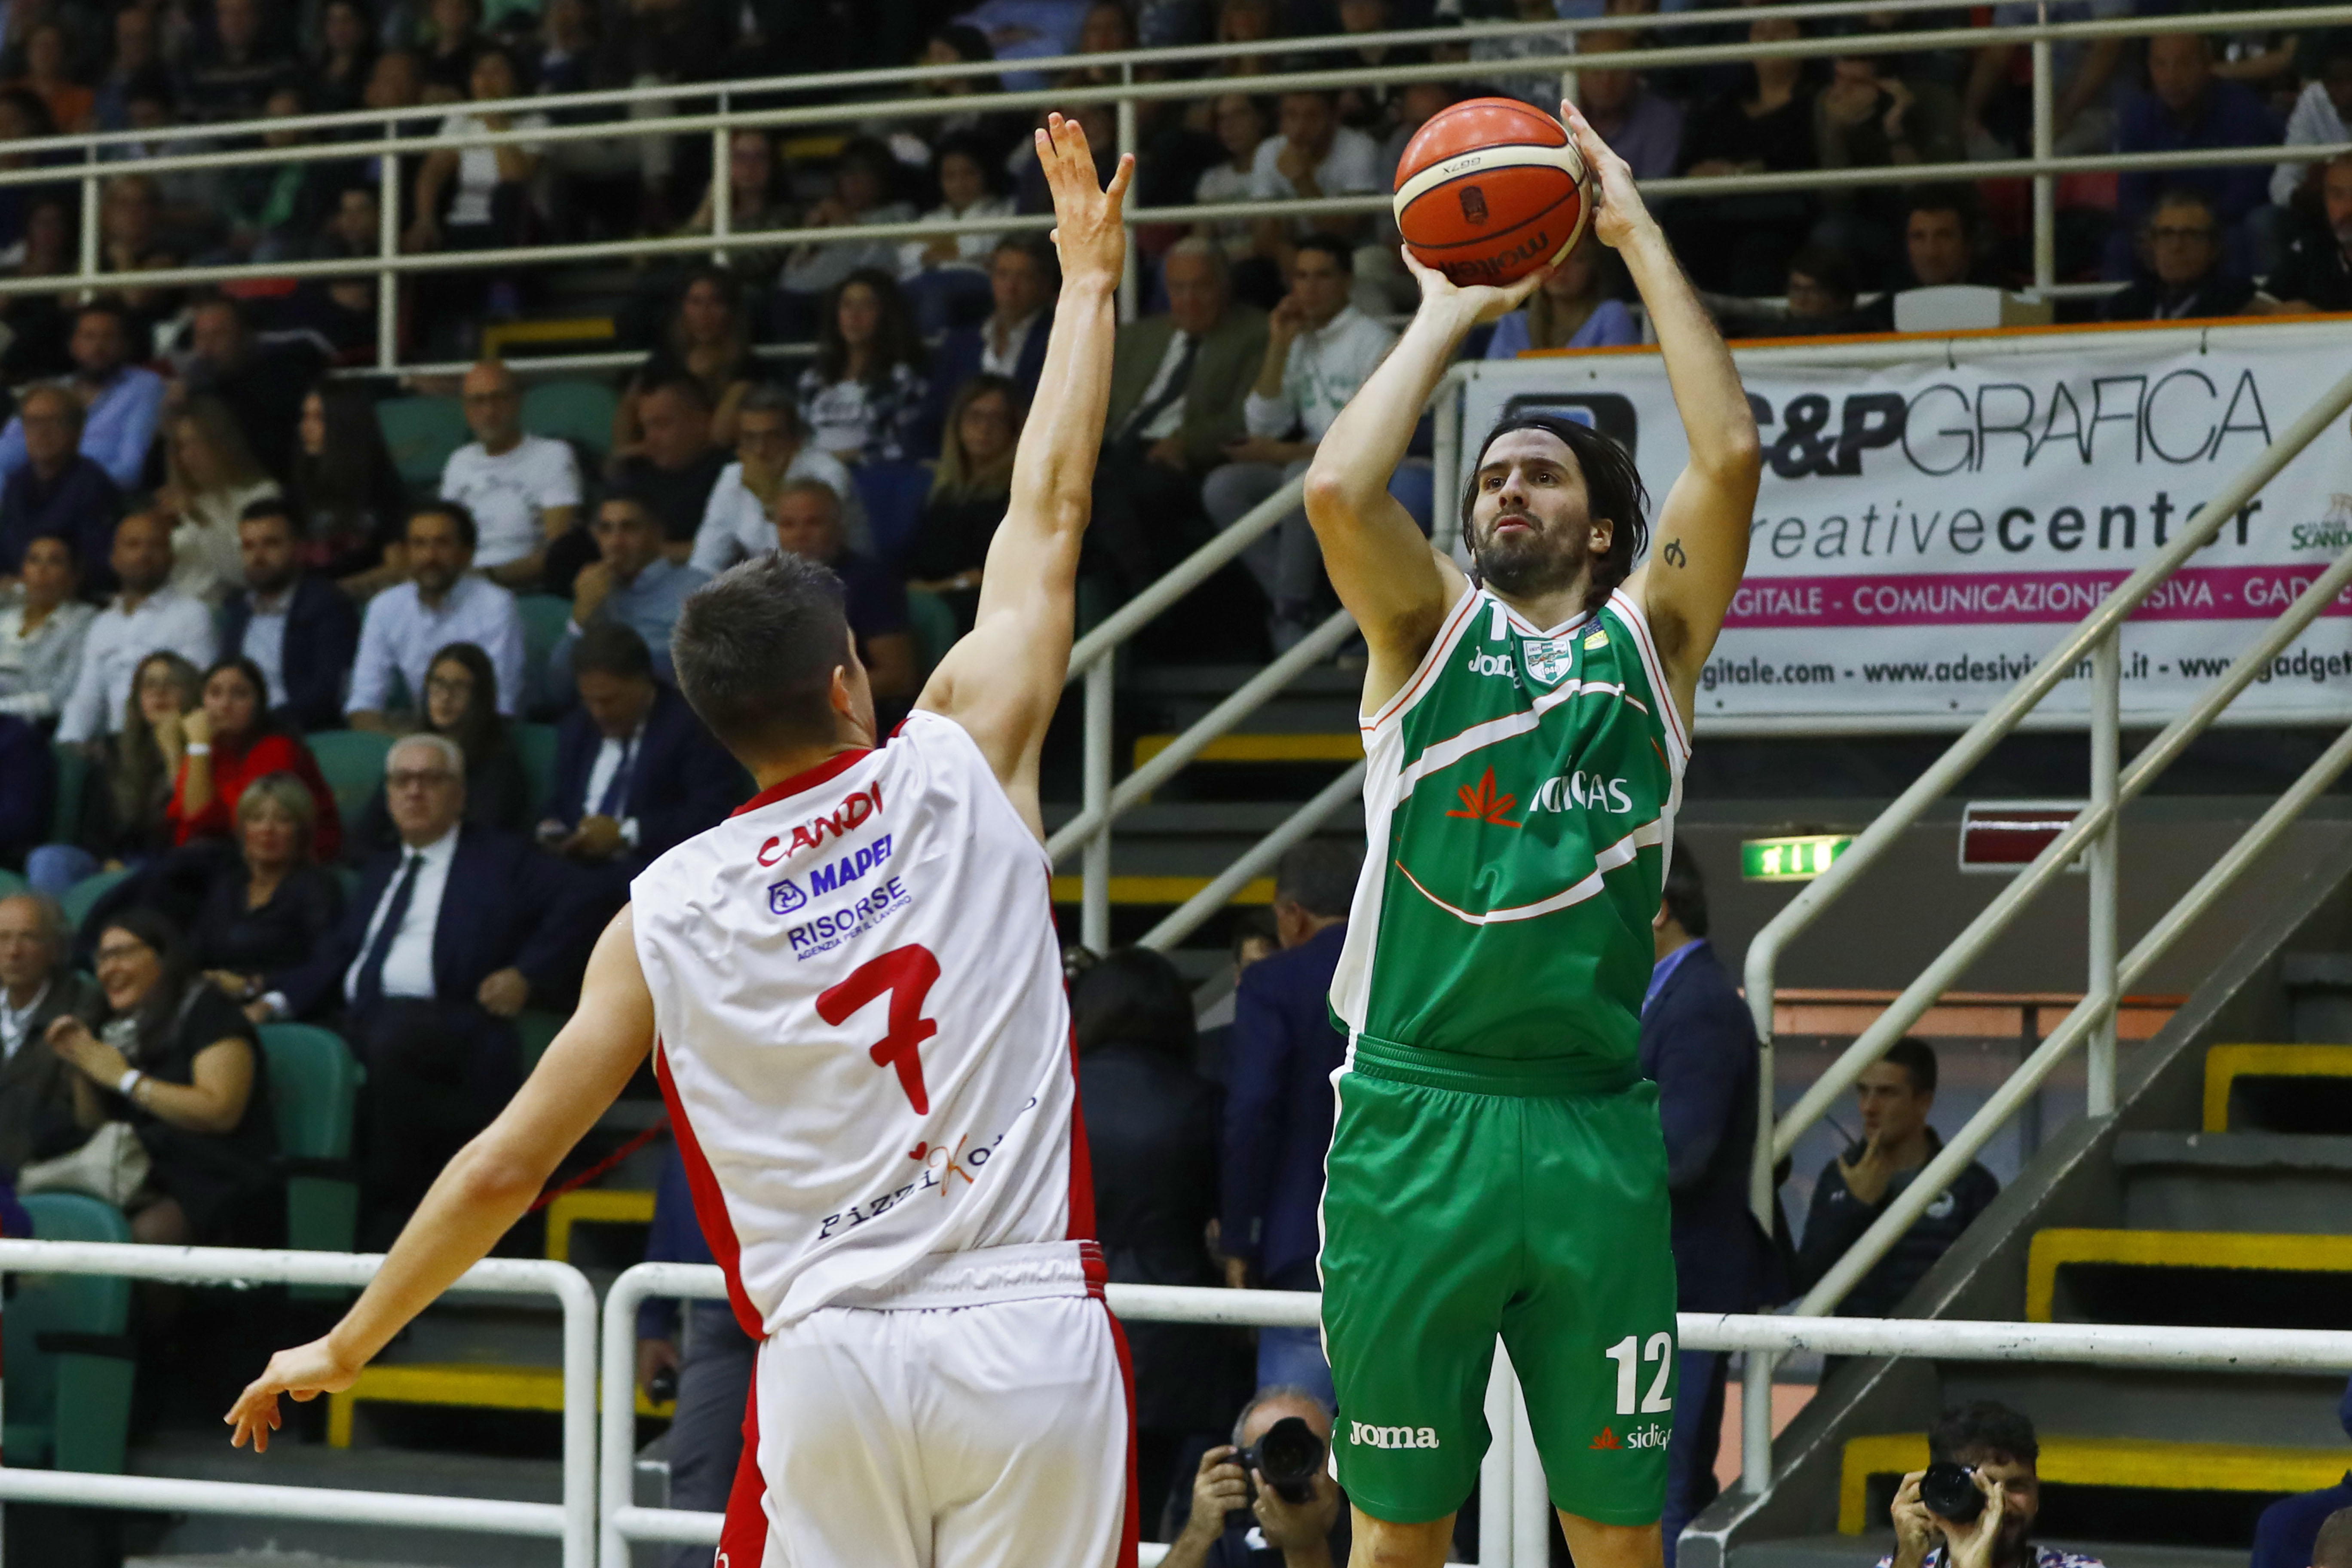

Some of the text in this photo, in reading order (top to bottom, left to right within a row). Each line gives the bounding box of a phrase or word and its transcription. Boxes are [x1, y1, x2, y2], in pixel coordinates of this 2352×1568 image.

[1725, 587, 1823, 616] GITALE
[757, 780, 883, 867] CANDI
[810, 834, 892, 897] MAPEI
[787, 876, 906, 950] RISORSE
[798, 938, 842, 962] AGENZIA
[816, 943, 941, 1115] 7
[1606, 1331, 1672, 1415] 12
[1350, 1420, 1439, 1449] Joma
